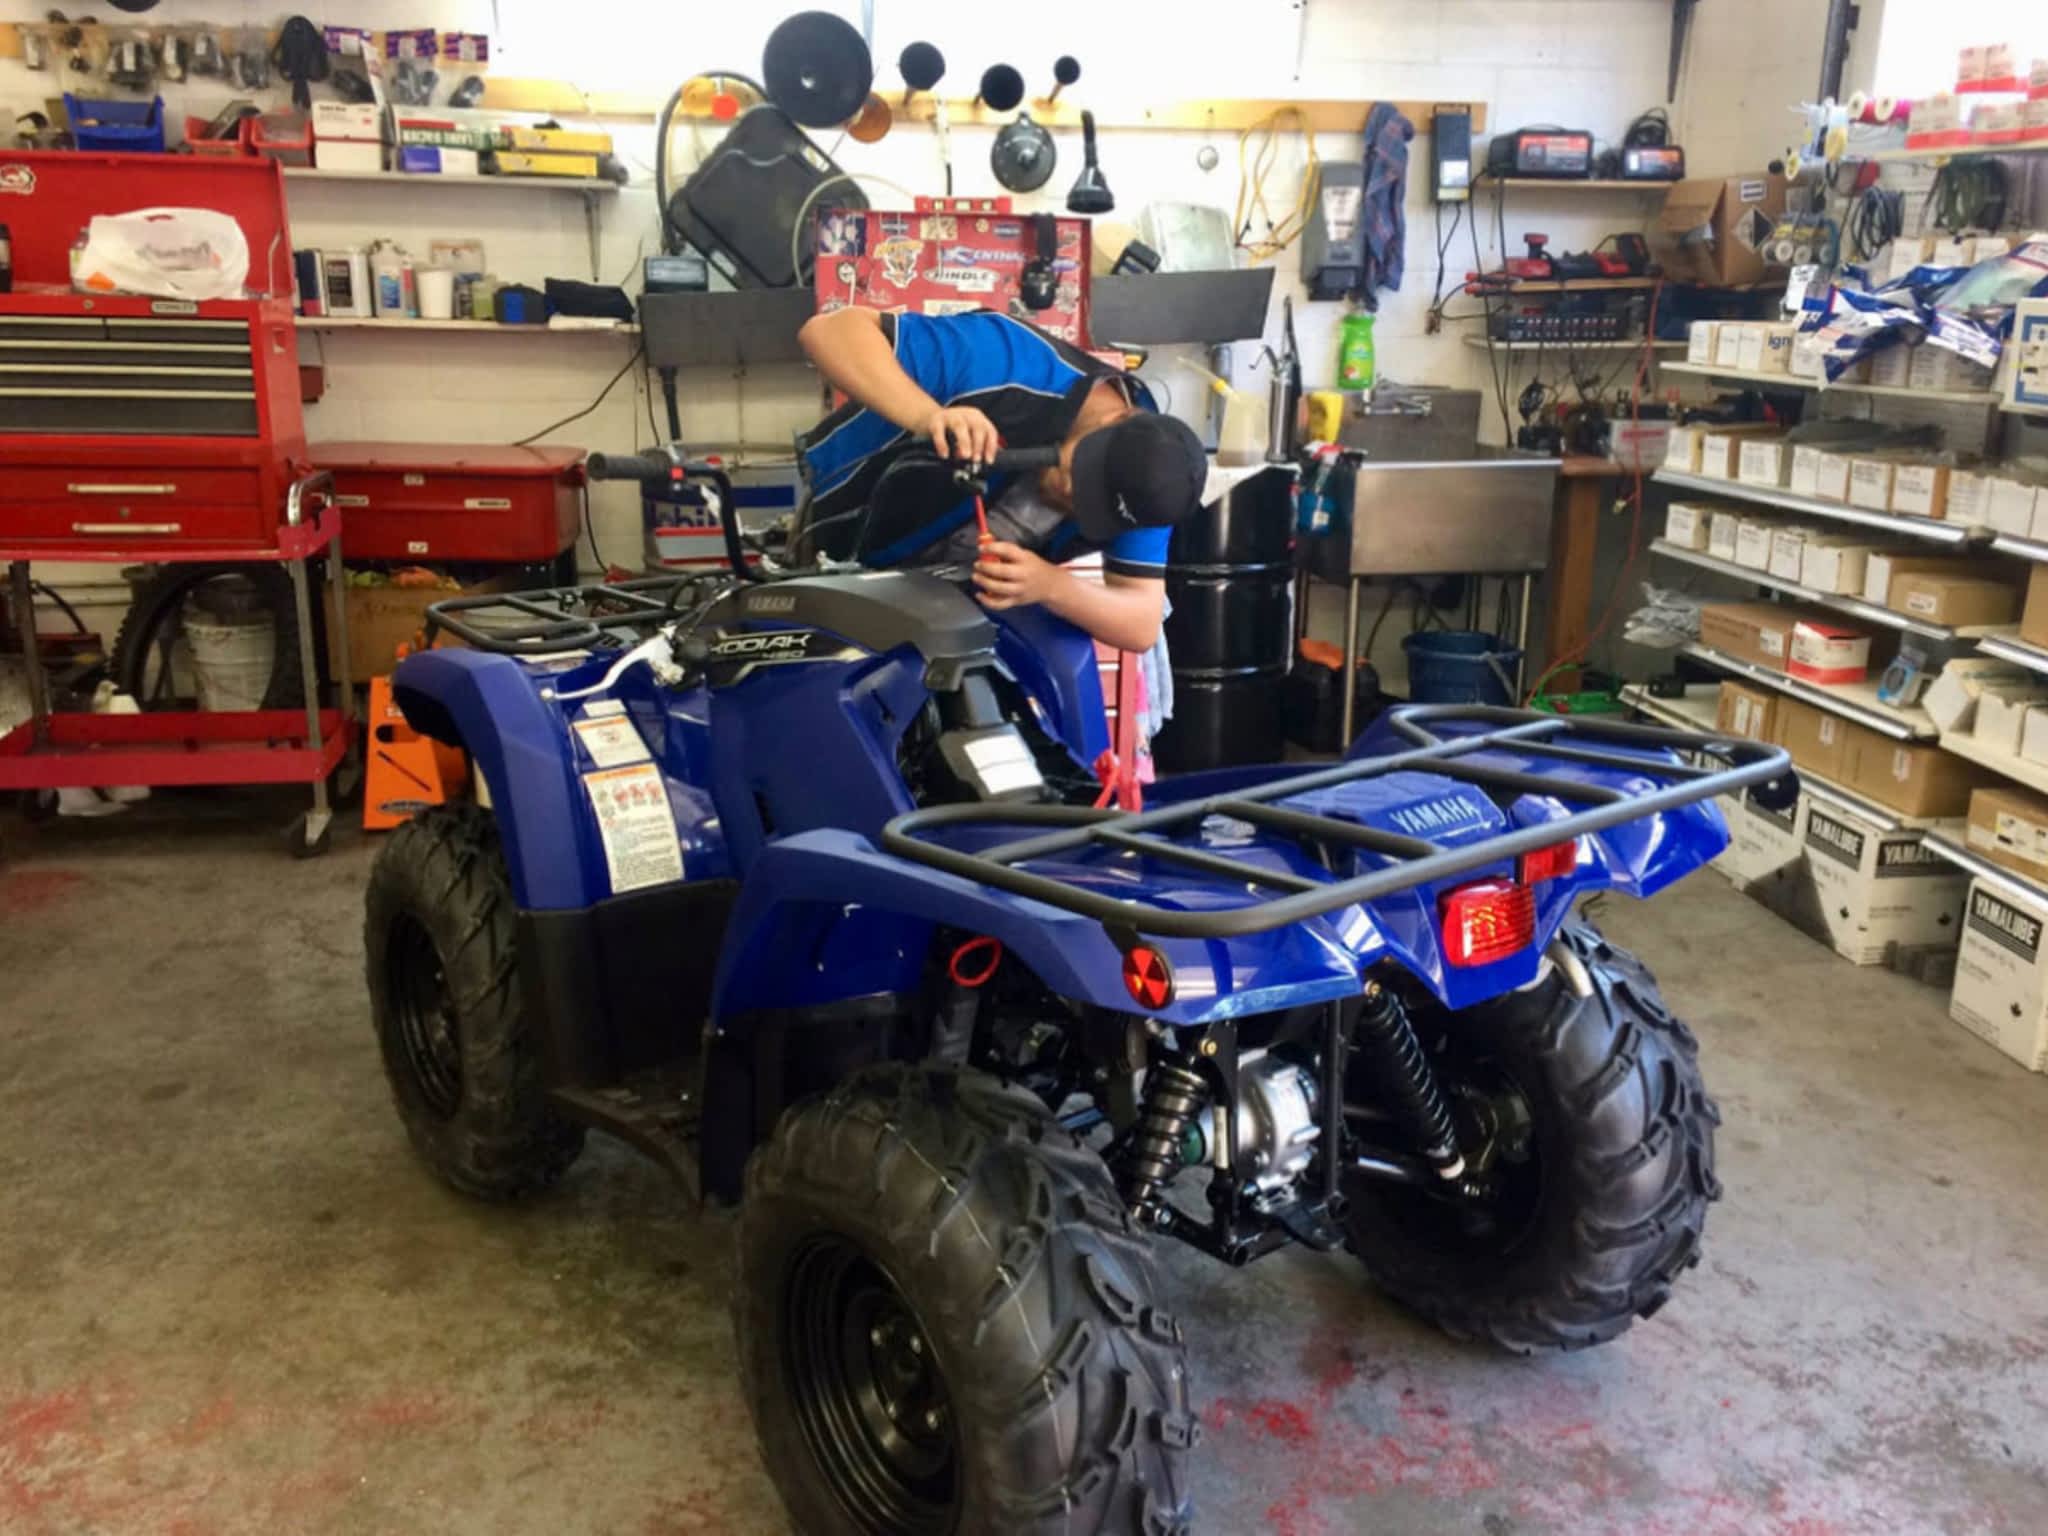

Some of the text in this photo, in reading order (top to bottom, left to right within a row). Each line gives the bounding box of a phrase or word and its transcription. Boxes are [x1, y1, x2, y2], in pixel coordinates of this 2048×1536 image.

[1388, 795, 1480, 835] YAMAHA
[1811, 812, 1859, 857] YAMALUBE
[1975, 893, 2039, 946] YAMALUBE
